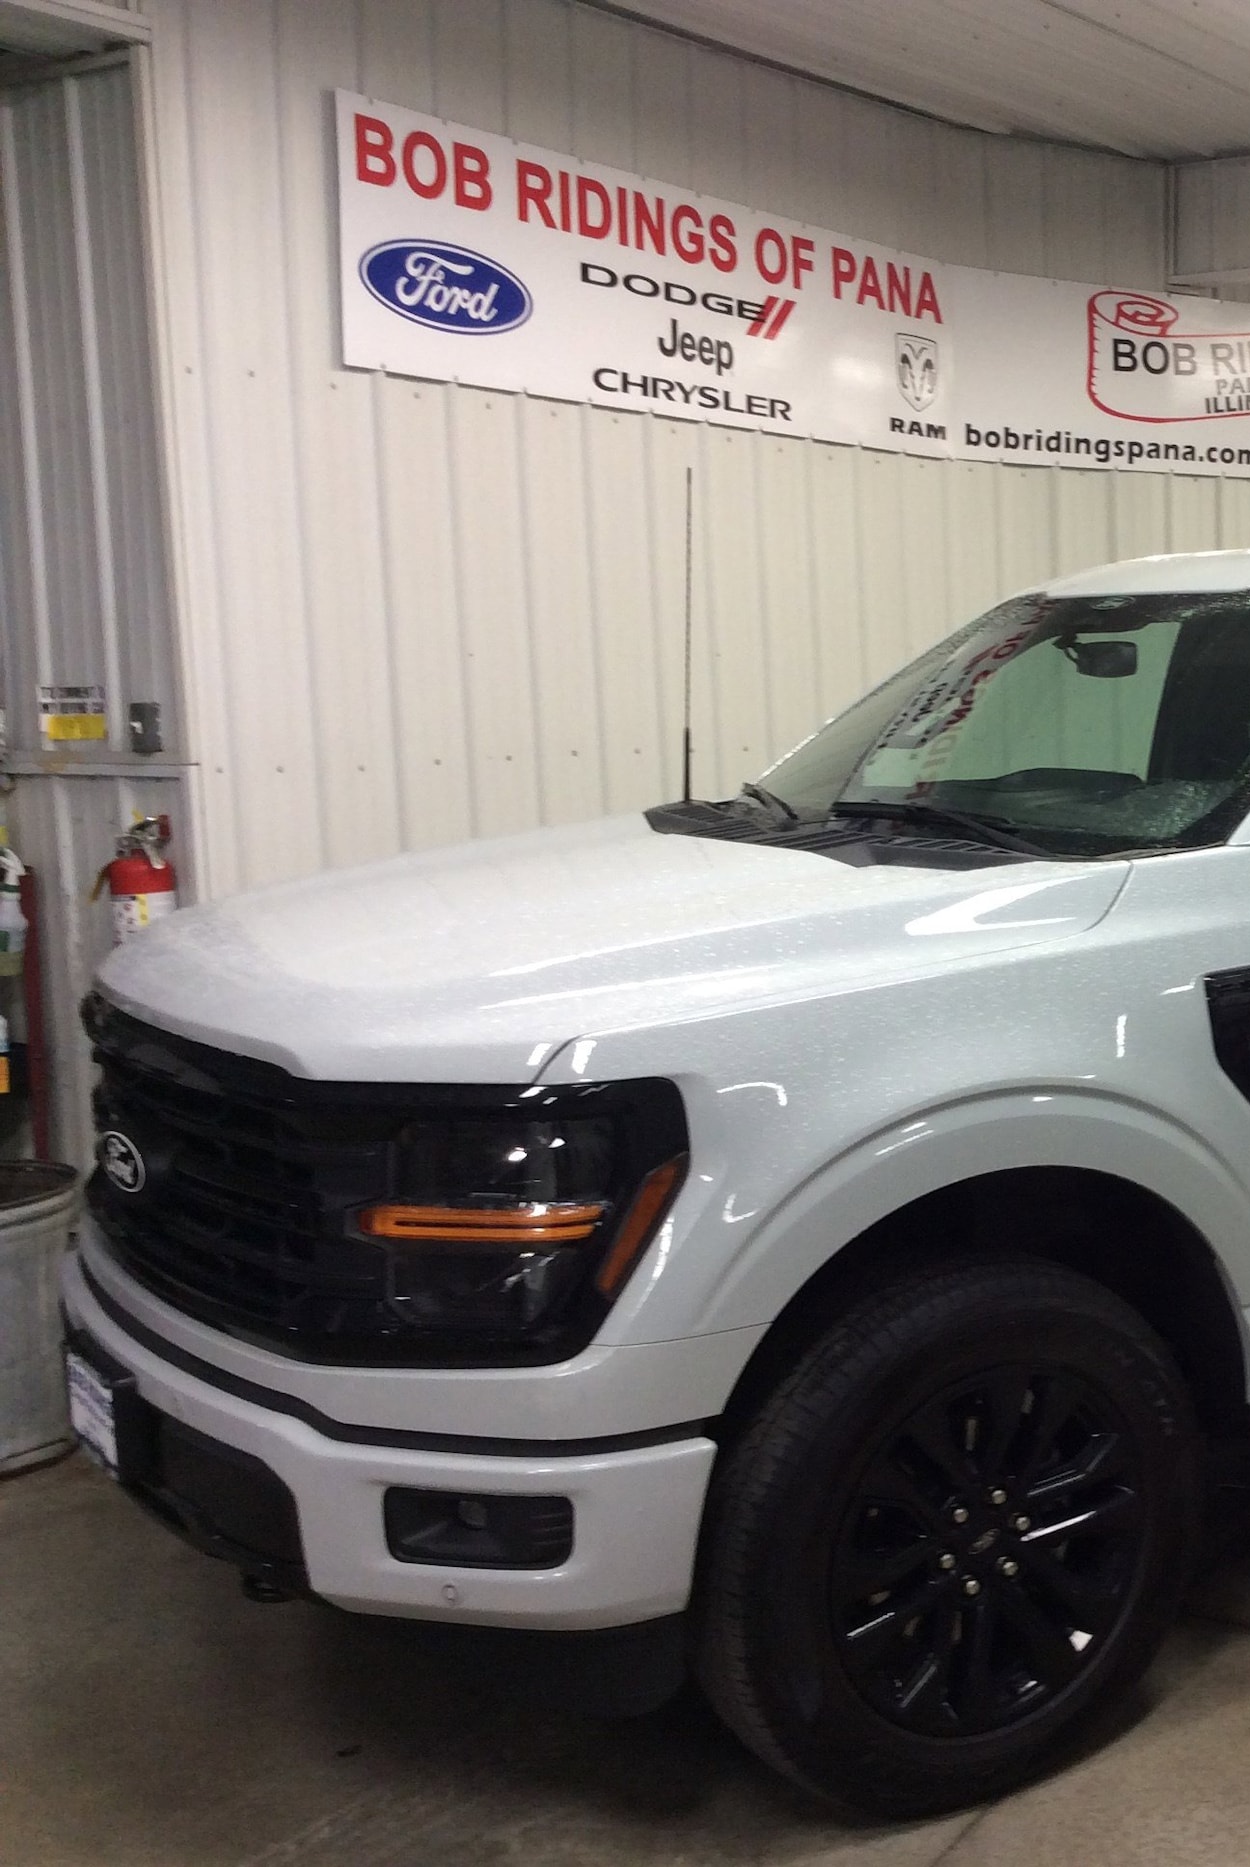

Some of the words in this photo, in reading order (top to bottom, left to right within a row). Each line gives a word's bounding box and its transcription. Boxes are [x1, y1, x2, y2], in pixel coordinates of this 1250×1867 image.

[354, 112, 493, 212] BOB
[516, 158, 738, 273] RIDINGS
[754, 227, 815, 290] OF
[831, 246, 944, 324] PANA
[394, 251, 500, 323] Ford
[580, 262, 767, 323] DODGE
[657, 318, 735, 376] Jeep
[1111, 338, 1198, 376] BOB
[592, 367, 793, 421] CHRYSLER
[889, 417, 947, 440] RAM
